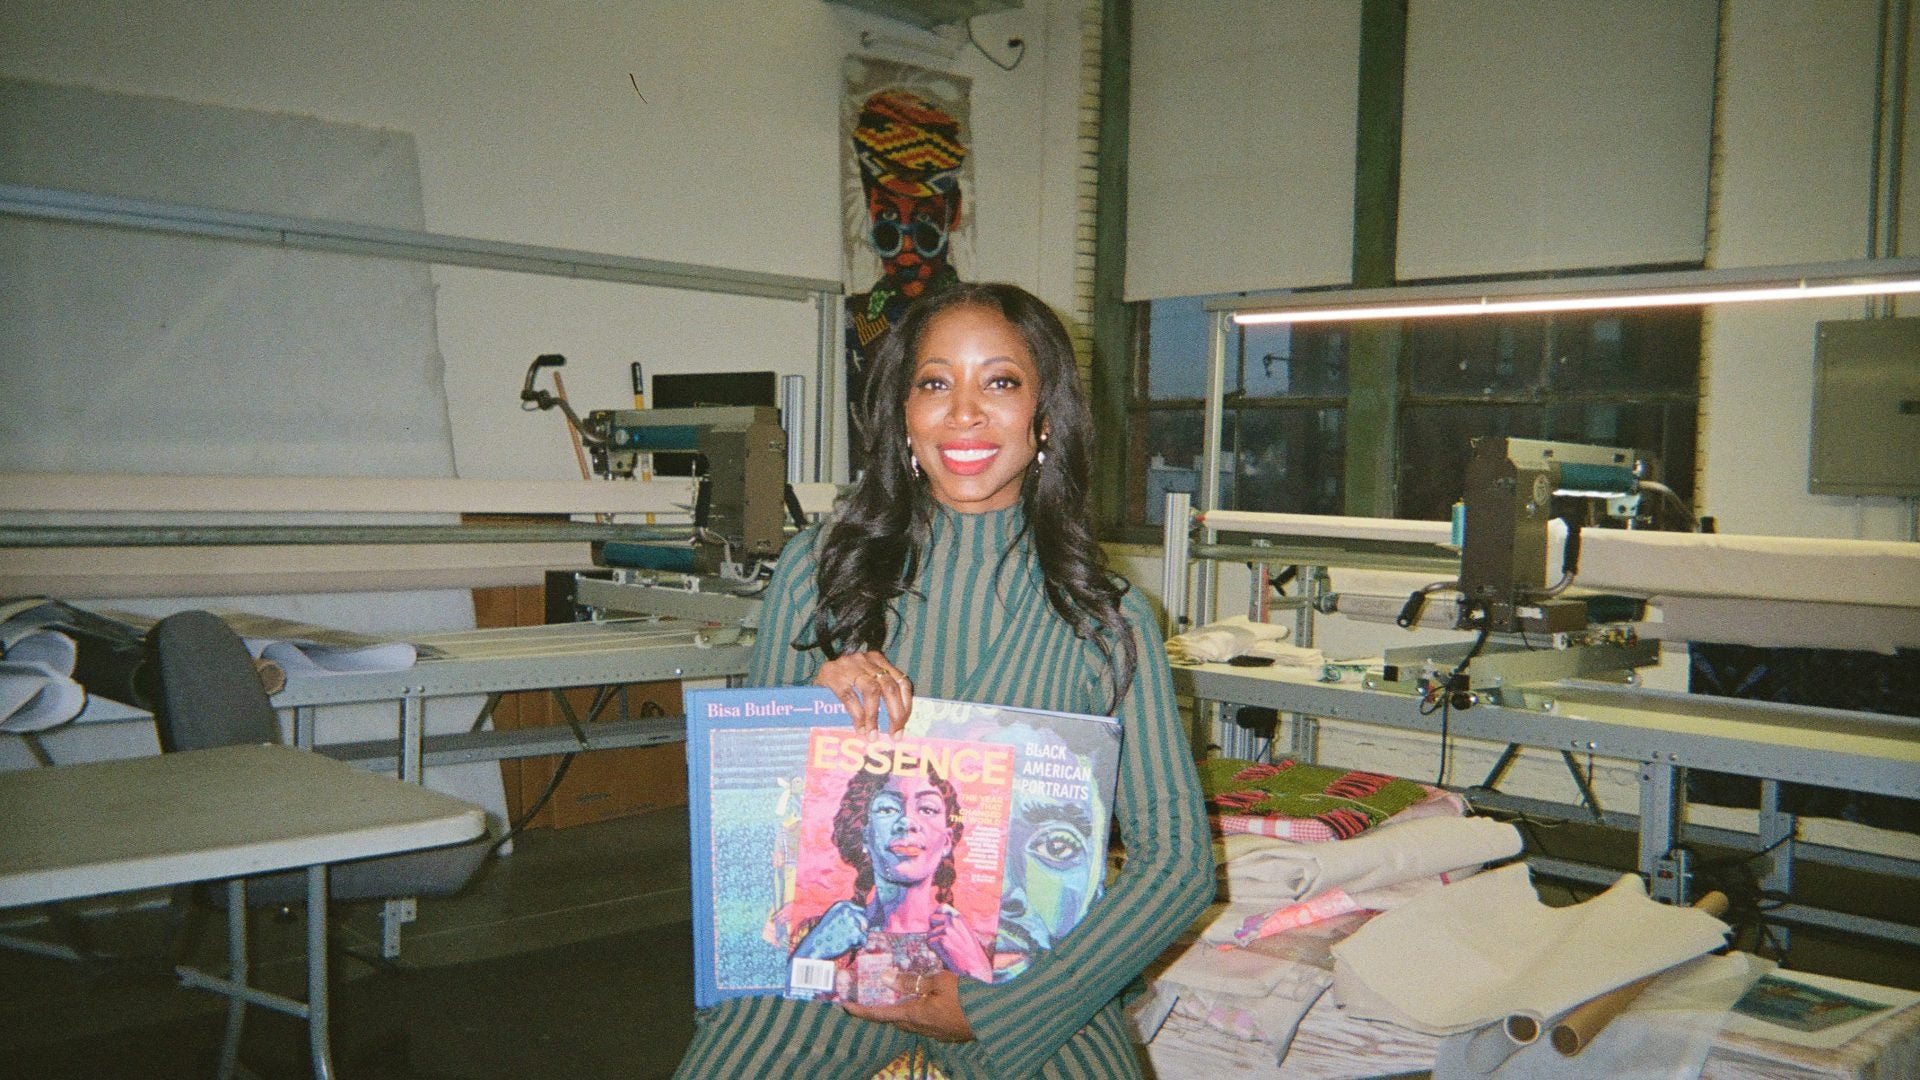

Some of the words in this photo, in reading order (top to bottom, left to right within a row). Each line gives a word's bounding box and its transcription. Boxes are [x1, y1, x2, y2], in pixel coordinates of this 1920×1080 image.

[707, 702, 741, 718] Bisa
[745, 699, 881, 717] Butler—Port
[813, 735, 1009, 785] ESSENCE
[1025, 742, 1067, 760] BLACK
[1022, 760, 1092, 781] AMERICAN
[1021, 779, 1089, 800] PORTRAITS
[950, 814, 965, 823] THE
